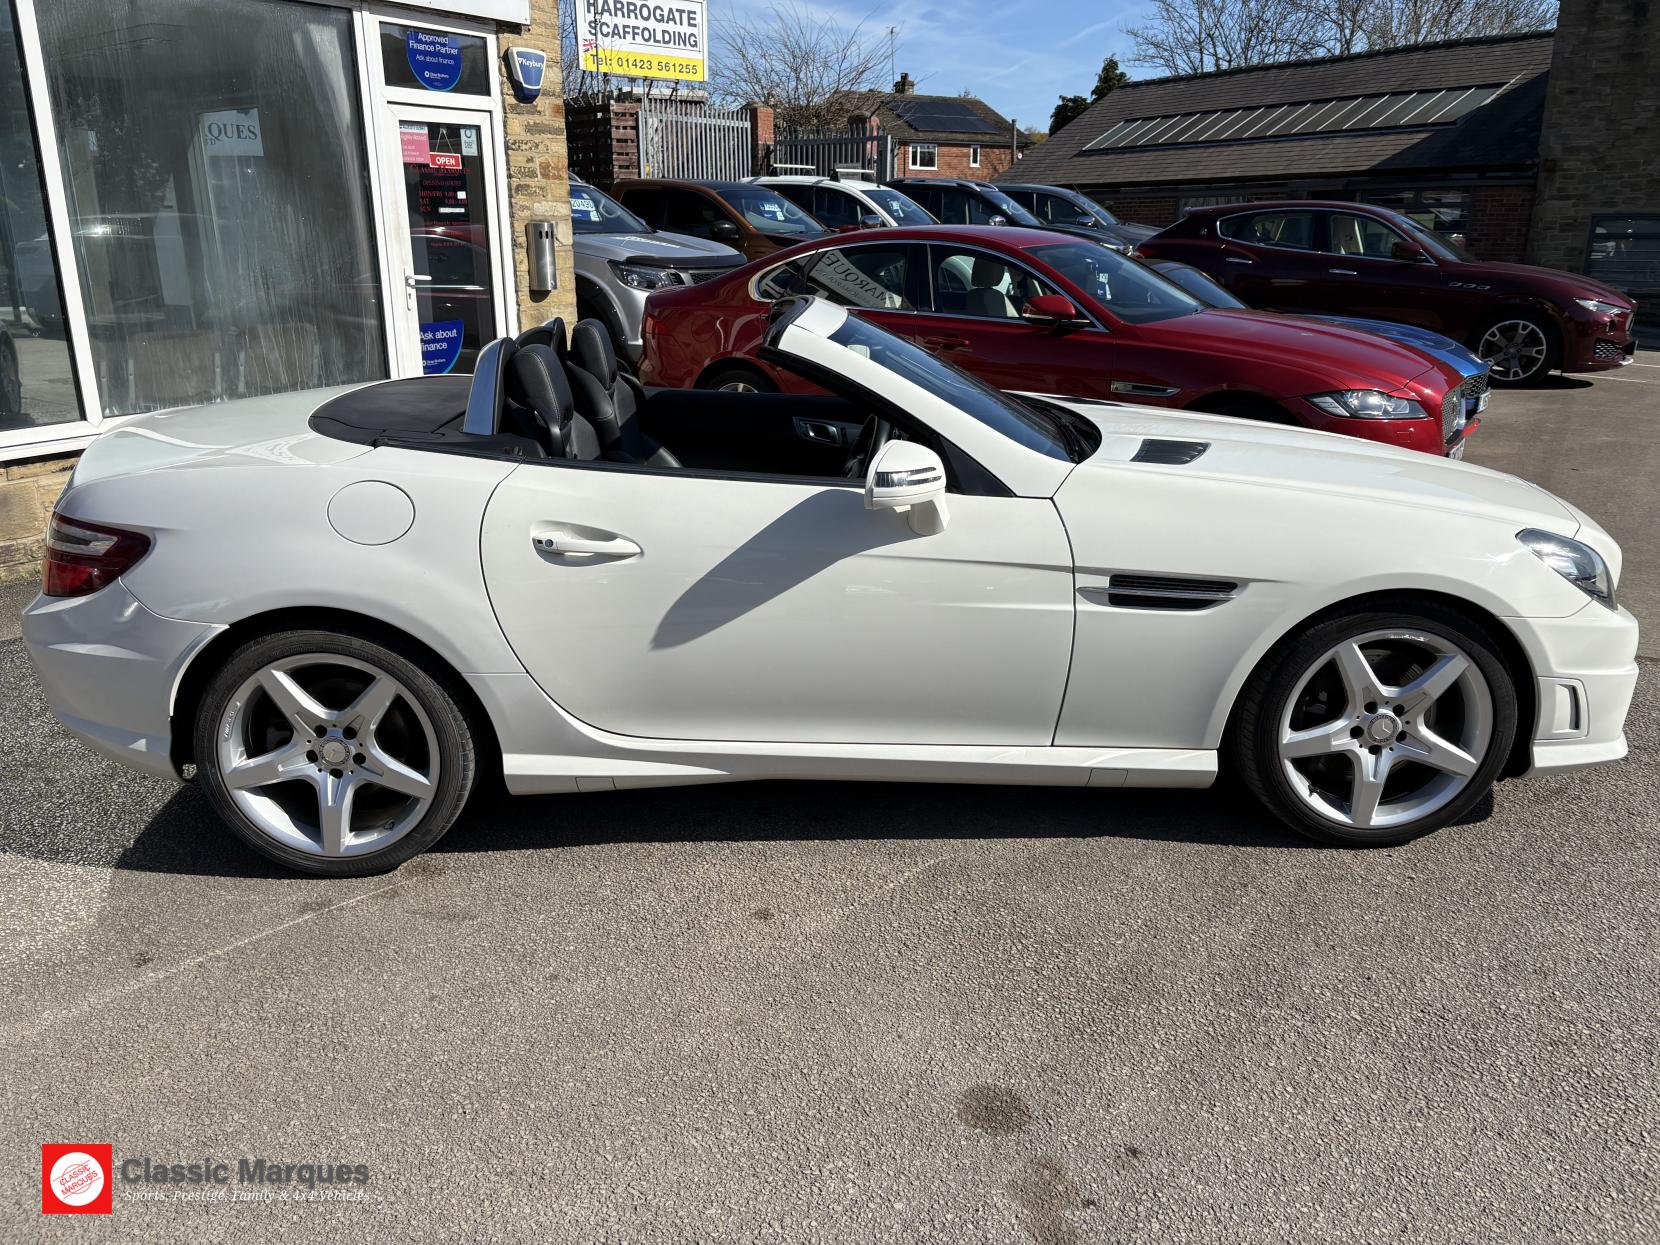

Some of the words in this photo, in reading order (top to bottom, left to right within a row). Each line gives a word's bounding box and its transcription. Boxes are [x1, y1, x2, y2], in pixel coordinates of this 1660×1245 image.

[587, 0, 698, 28] HARROGATE
[418, 32, 449, 44] Approved
[588, 20, 698, 48] SCAFFOLDING
[410, 40, 435, 52] Finance
[435, 44, 458, 55] Partner
[522, 58, 544, 70] Keybury
[590, 53, 613, 66] Tel:
[616, 56, 653, 70] 01423
[657, 61, 698, 75] 561255
[435, 156, 456, 166] OPEN
[435, 328, 457, 339] about
